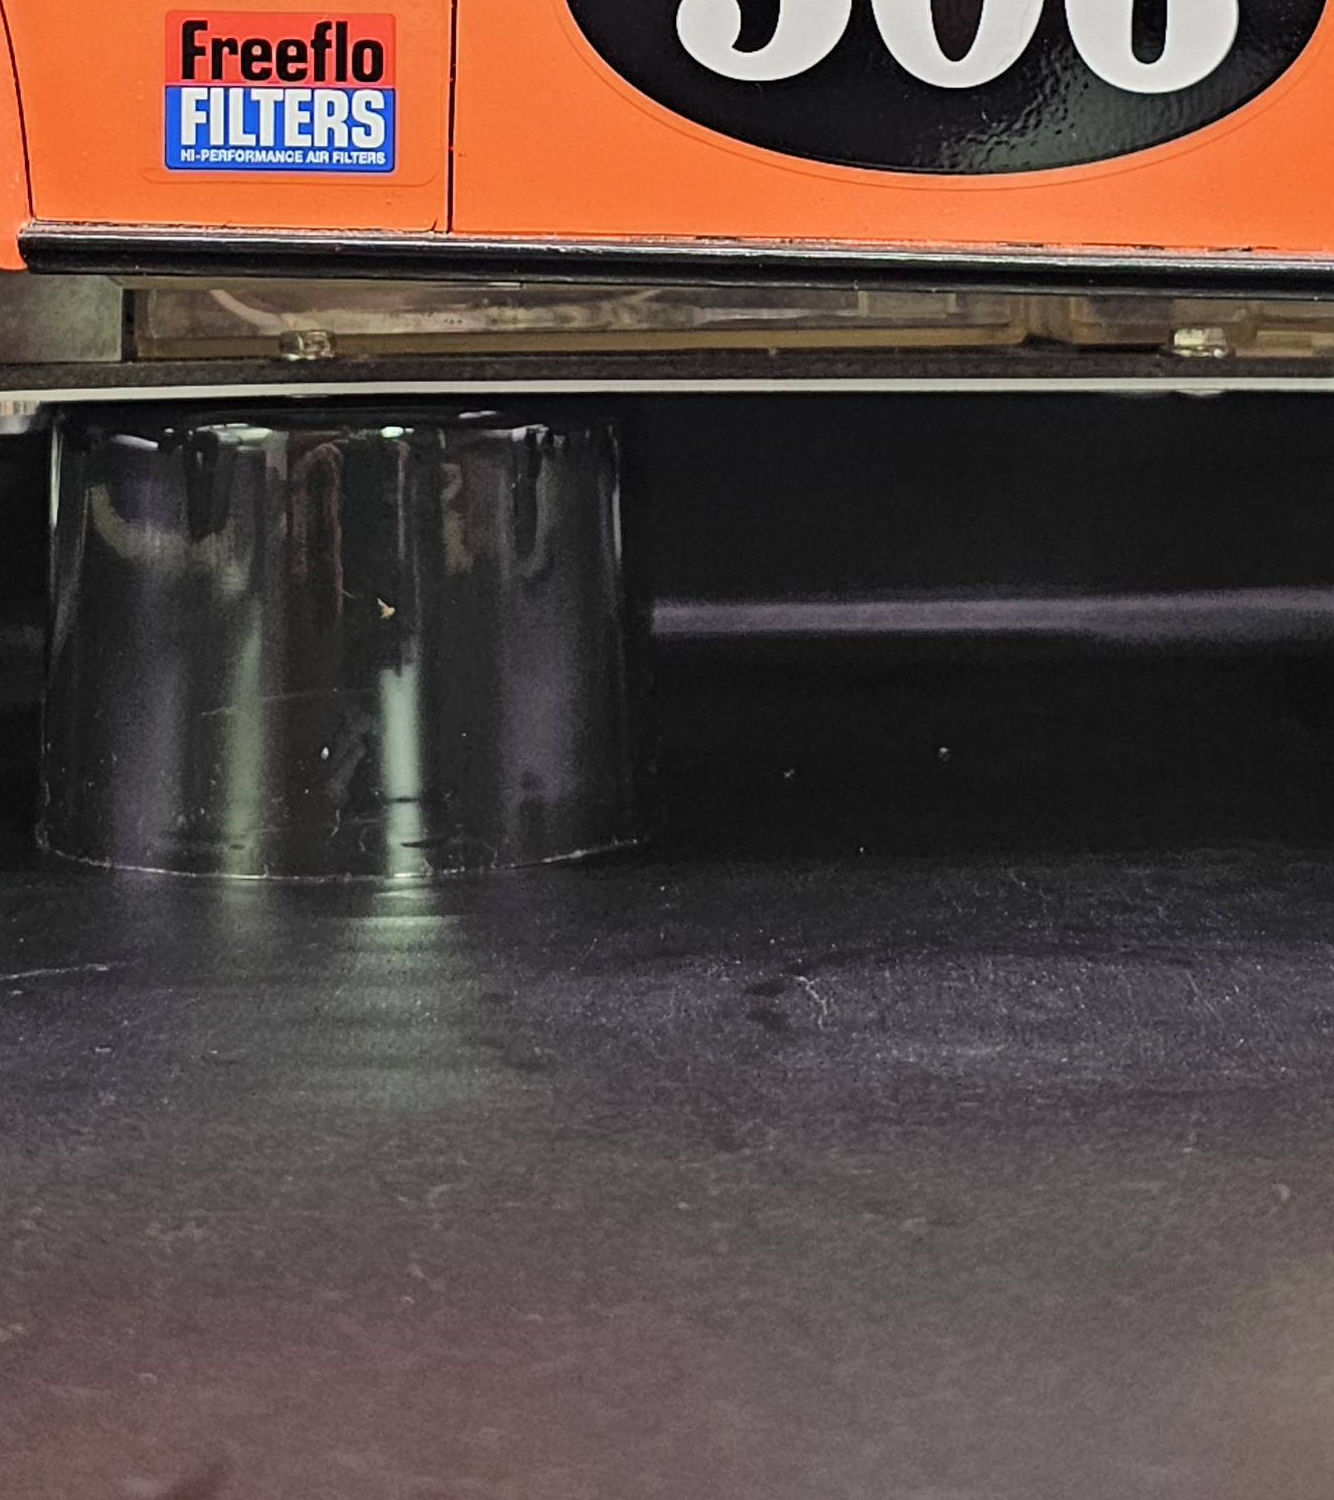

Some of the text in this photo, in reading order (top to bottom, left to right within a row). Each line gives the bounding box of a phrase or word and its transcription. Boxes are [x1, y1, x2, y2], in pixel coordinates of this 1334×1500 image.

[181, 19, 384, 84] Freeflo
[181, 87, 386, 149] FILTERS
[180, 148, 386, 165] HI-PERFORMANCE AIR FILTERS
